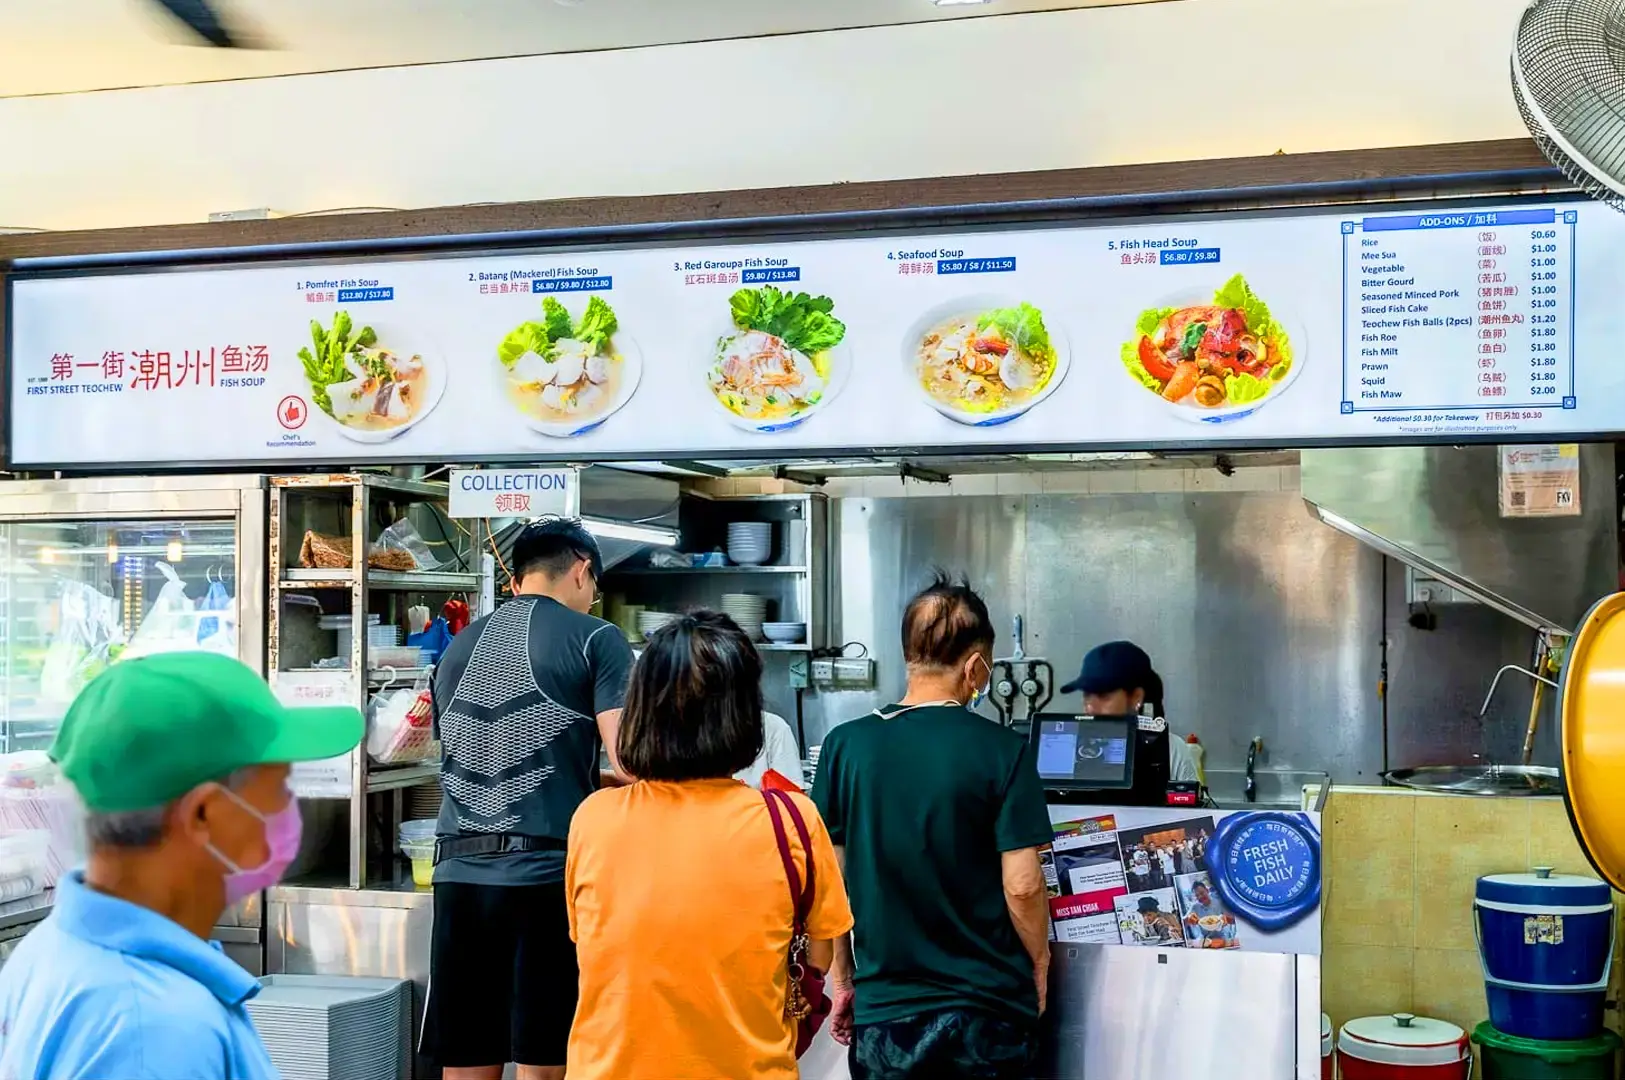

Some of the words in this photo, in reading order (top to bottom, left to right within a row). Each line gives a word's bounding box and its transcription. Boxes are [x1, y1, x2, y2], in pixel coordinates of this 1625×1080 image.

[1419, 216, 1465, 227] ADD-ONS
[1475, 213, 1497, 224] 加料
[1531, 230, 1556, 239] $0.60
[1108, 241, 1118, 250] 5.
[1120, 240, 1140, 249] Fish
[1143, 238, 1169, 248] Head
[1172, 237, 1198, 248] Soup
[1531, 244, 1556, 253] $1.00
[887, 252, 896, 260] 4.
[898, 249, 937, 260] Seafood
[939, 248, 964, 259] Soup
[1120, 252, 1156, 265] 鱼头汤
[1164, 253, 1186, 262] $6.80
[1195, 251, 1217, 261] $9.80
[1361, 252, 1380, 260] Mee
[1381, 251, 1397, 259] Sua
[674, 262, 682, 271] 3.
[685, 261, 702, 270] Red
[704, 260, 743, 271] Garoupa
[745, 258, 763, 267] Fish
[765, 257, 788, 268] Soup
[941, 262, 962, 272] $5.80
[969, 262, 979, 271] $8
[986, 260, 1013, 270] $11.50
[1531, 258, 1556, 267] $1.00
[898, 262, 934, 275] 海鲜汤
[1362, 264, 1405, 274] Vegetable
[468, 273, 477, 282] 2.
[478, 272, 508, 282] Batang
[510, 268, 556, 281] (Mackerel)
[557, 268, 575, 276] Fish
[576, 267, 598, 277] Soup
[685, 272, 739, 285] 红石斑鱼汤
[745, 271, 766, 281] $9.80
[772, 270, 797, 280] $13.80
[1478, 272, 1507, 283] (苦瓜)
[1531, 272, 1556, 281] $1.00
[297, 282, 304, 290] 1.
[305, 280, 338, 289] Pomfret
[340, 279, 357, 288] Fish
[358, 278, 379, 288] Soup
[1362, 279, 1385, 287] Bitter
[1387, 277, 1415, 286] Gourd
[479, 282, 530, 294] 巴当鱼片汤
[1531, 286, 1556, 295] $1.00
[1361, 292, 1402, 301] Seasoned
[1404, 291, 1437, 299] Minced
[1439, 289, 1459, 298] Pork
[1361, 306, 1386, 314] Sliced
[1388, 305, 1405, 313] Fish
[1407, 304, 1428, 313] Cake
[1531, 299, 1556, 308] $1.00
[1362, 320, 1400, 328] Teochew
[1403, 319, 1420, 327] Fish
[1422, 318, 1444, 326] Balls
[1446, 317, 1473, 327] (2pcs)
[1531, 315, 1556, 324] $1.20
[1361, 334, 1379, 342] Fish
[1380, 333, 1397, 341] Roe
[1531, 328, 1556, 337] $1.80
[1361, 348, 1379, 356] Fish
[1380, 348, 1398, 356] Milt
[1478, 343, 1507, 354] (鱼白)
[1531, 343, 1556, 352] $1.80
[1362, 363, 1389, 371] Prawn
[1531, 358, 1556, 367] $1.80
[1361, 377, 1385, 386] Squid
[1531, 372, 1556, 381] $1.80
[220, 378, 239, 388] FISH
[241, 377, 266, 387] SOUP
[27, 386, 48, 395] FIRST
[50, 385, 79, 394] STREET
[82, 383, 123, 393] TEOCHEW
[1531, 386, 1556, 395] $2.00
[1432, 414, 1444, 422] for
[1445, 413, 1479, 421] Takeaway
[1522, 411, 1543, 420] $0.30
[461, 474, 566, 491] COLLECTION
[495, 493, 531, 512] 领取
[1243, 838, 1289, 862] FRESH
[1254, 854, 1287, 873] FISH
[1254, 865, 1294, 888] DAILY
